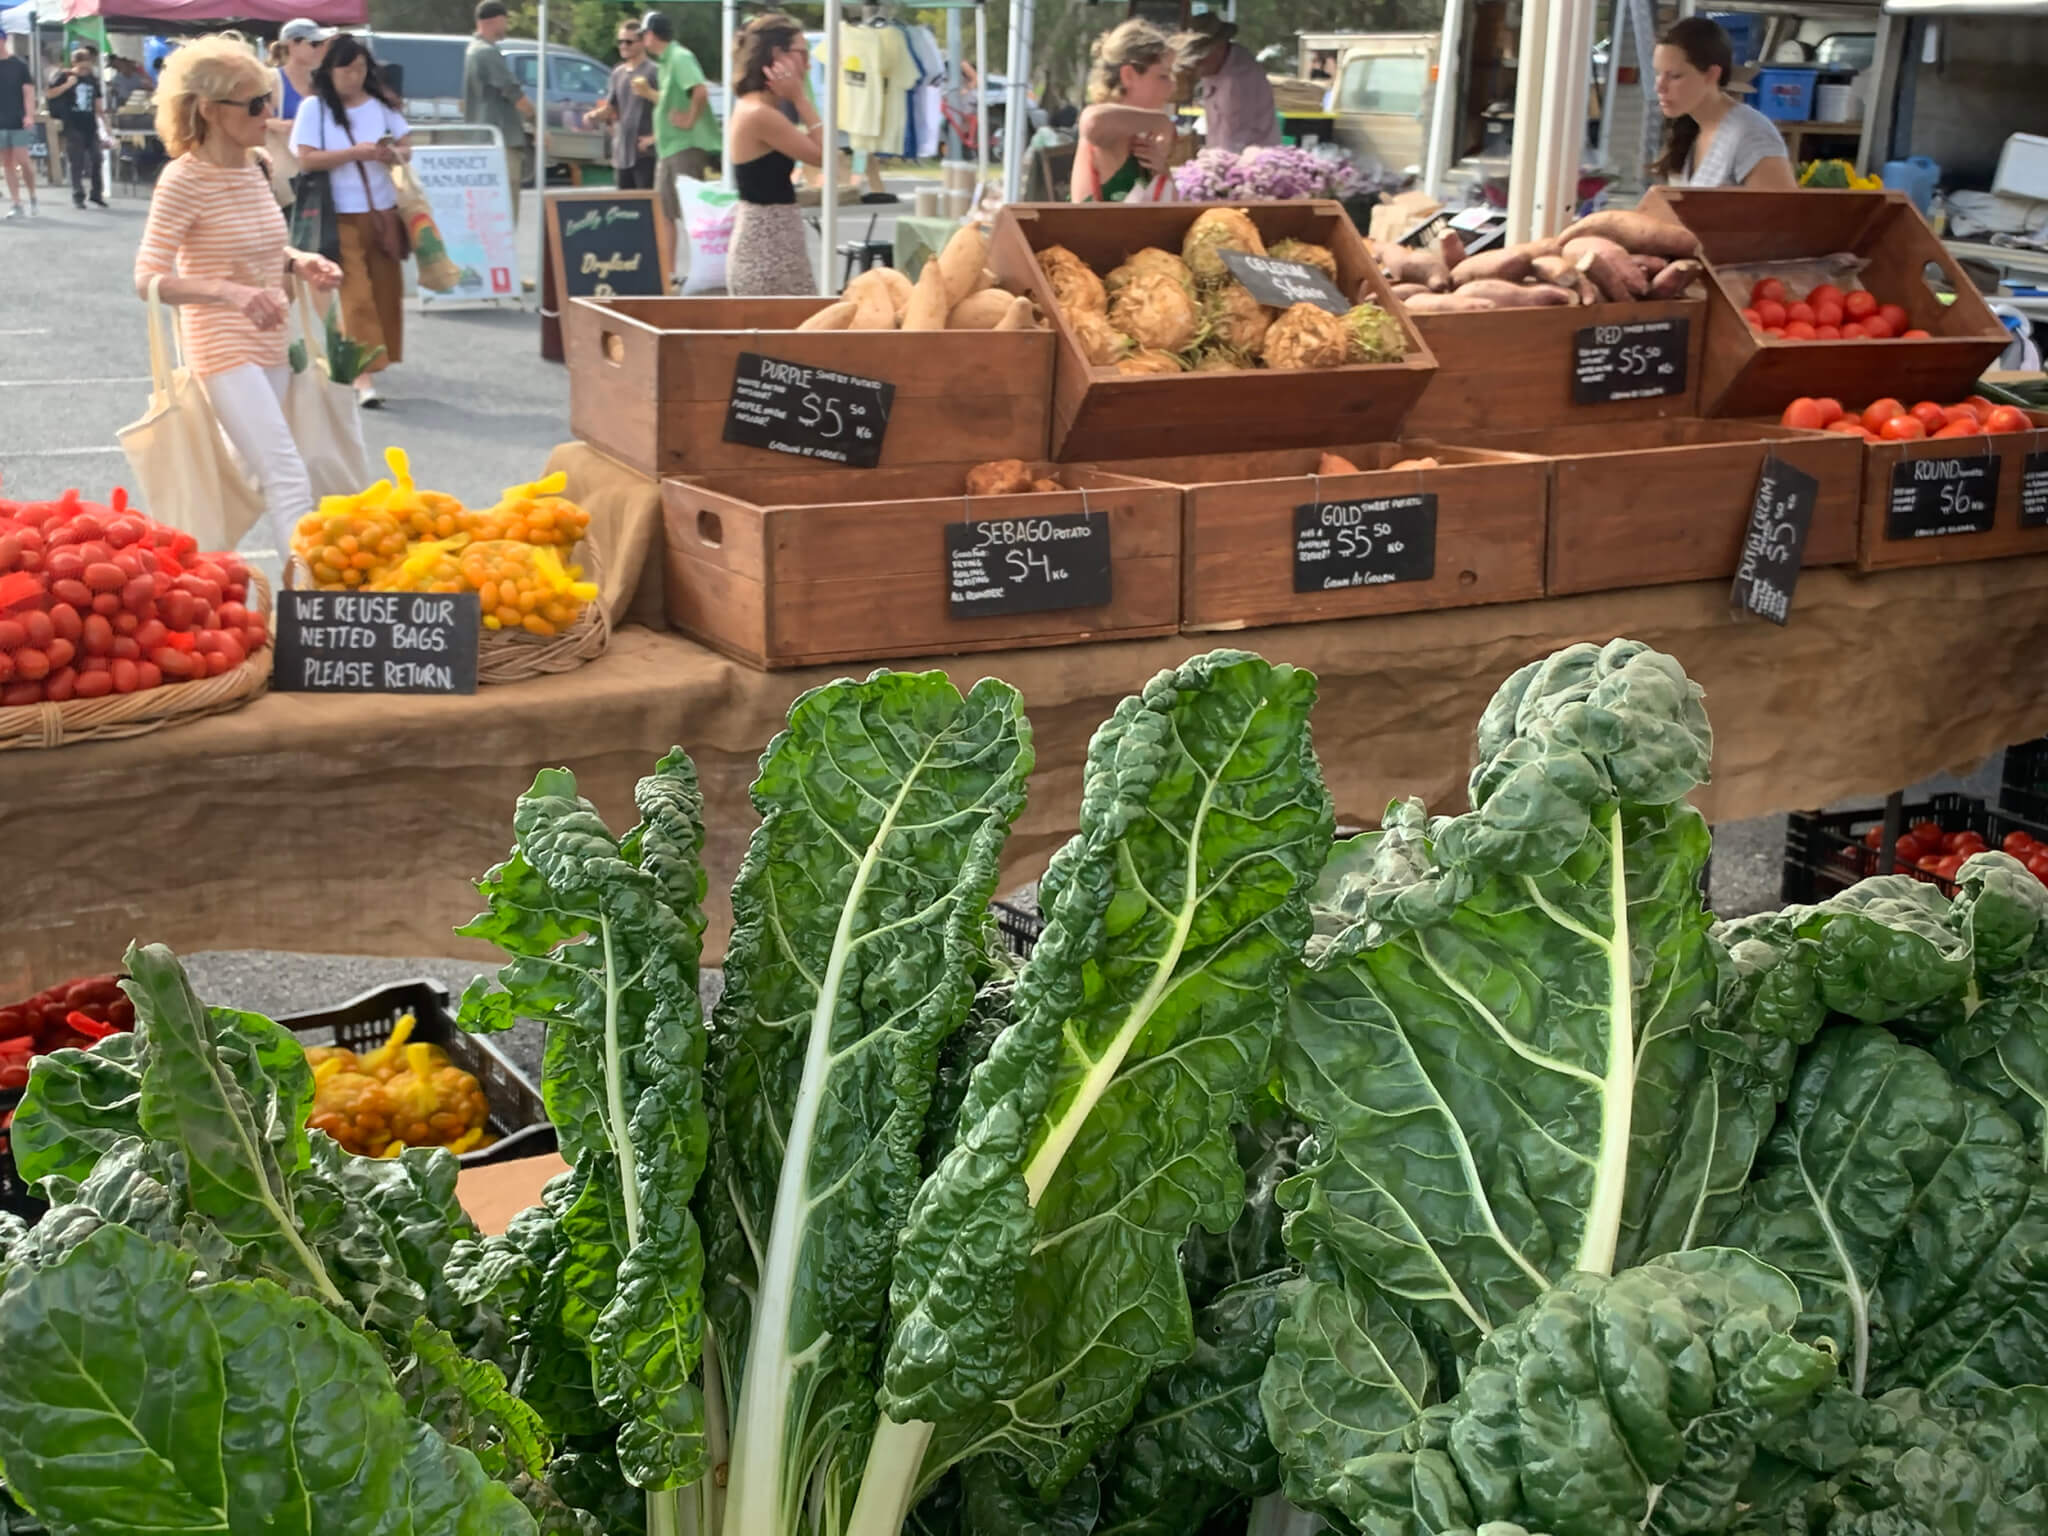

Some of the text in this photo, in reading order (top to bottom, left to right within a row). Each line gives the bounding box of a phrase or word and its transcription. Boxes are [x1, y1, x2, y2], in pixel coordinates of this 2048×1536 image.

[421, 156, 488, 169] MARKET
[581, 252, 642, 278] Dryland
[1595, 326, 1621, 344] RED
[1645, 346, 1661, 358] 50
[760, 359, 813, 388] PURPLE
[798, 392, 866, 437] $5 50
[1914, 460, 1960, 480] ROUND
[1321, 505, 1361, 526] GOLD
[976, 520, 1091, 547] SEBAGO POTATO
[1337, 523, 1391, 558] $5 50
[1738, 477, 1776, 581] DUTCH CREAM
[1387, 541, 1405, 553] KG
[1005, 548, 1069, 582] $4 KG
[295, 597, 454, 626] WE REUSE OUR
[300, 626, 376, 649] NETTED
[304, 657, 374, 688] PLEASE
